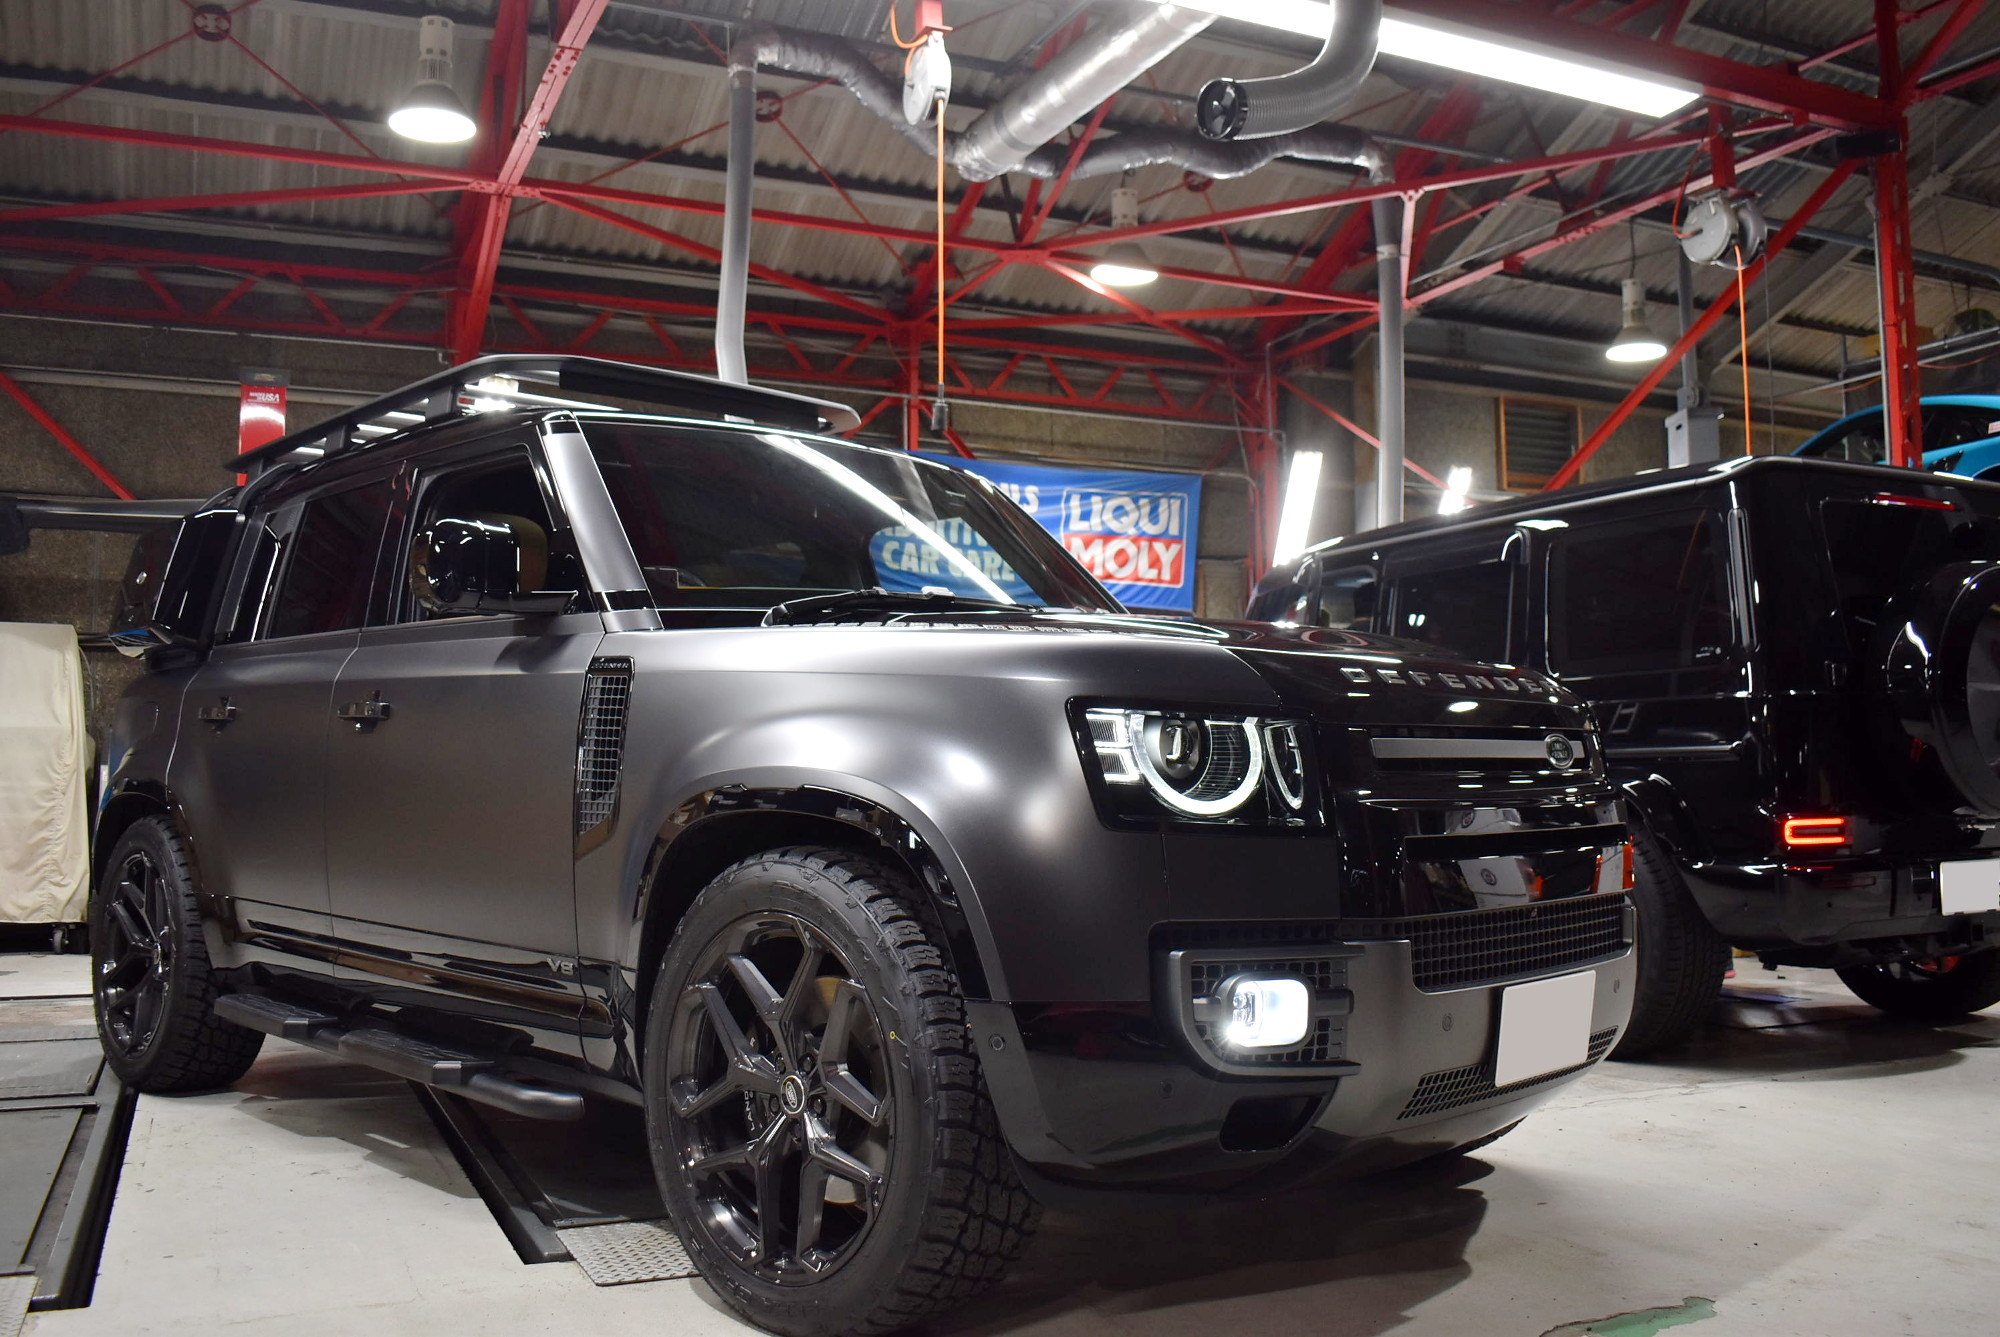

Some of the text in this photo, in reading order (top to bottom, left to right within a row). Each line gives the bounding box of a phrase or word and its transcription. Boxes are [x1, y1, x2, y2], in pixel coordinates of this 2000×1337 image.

[1068, 491, 1182, 538] LIQUI
[882, 540, 940, 575] CAR
[1070, 537, 1183, 582] MOLY
[1339, 667, 1566, 695] DEFENDER
[546, 957, 574, 976] V8
[744, 1091, 755, 1131] LAND
